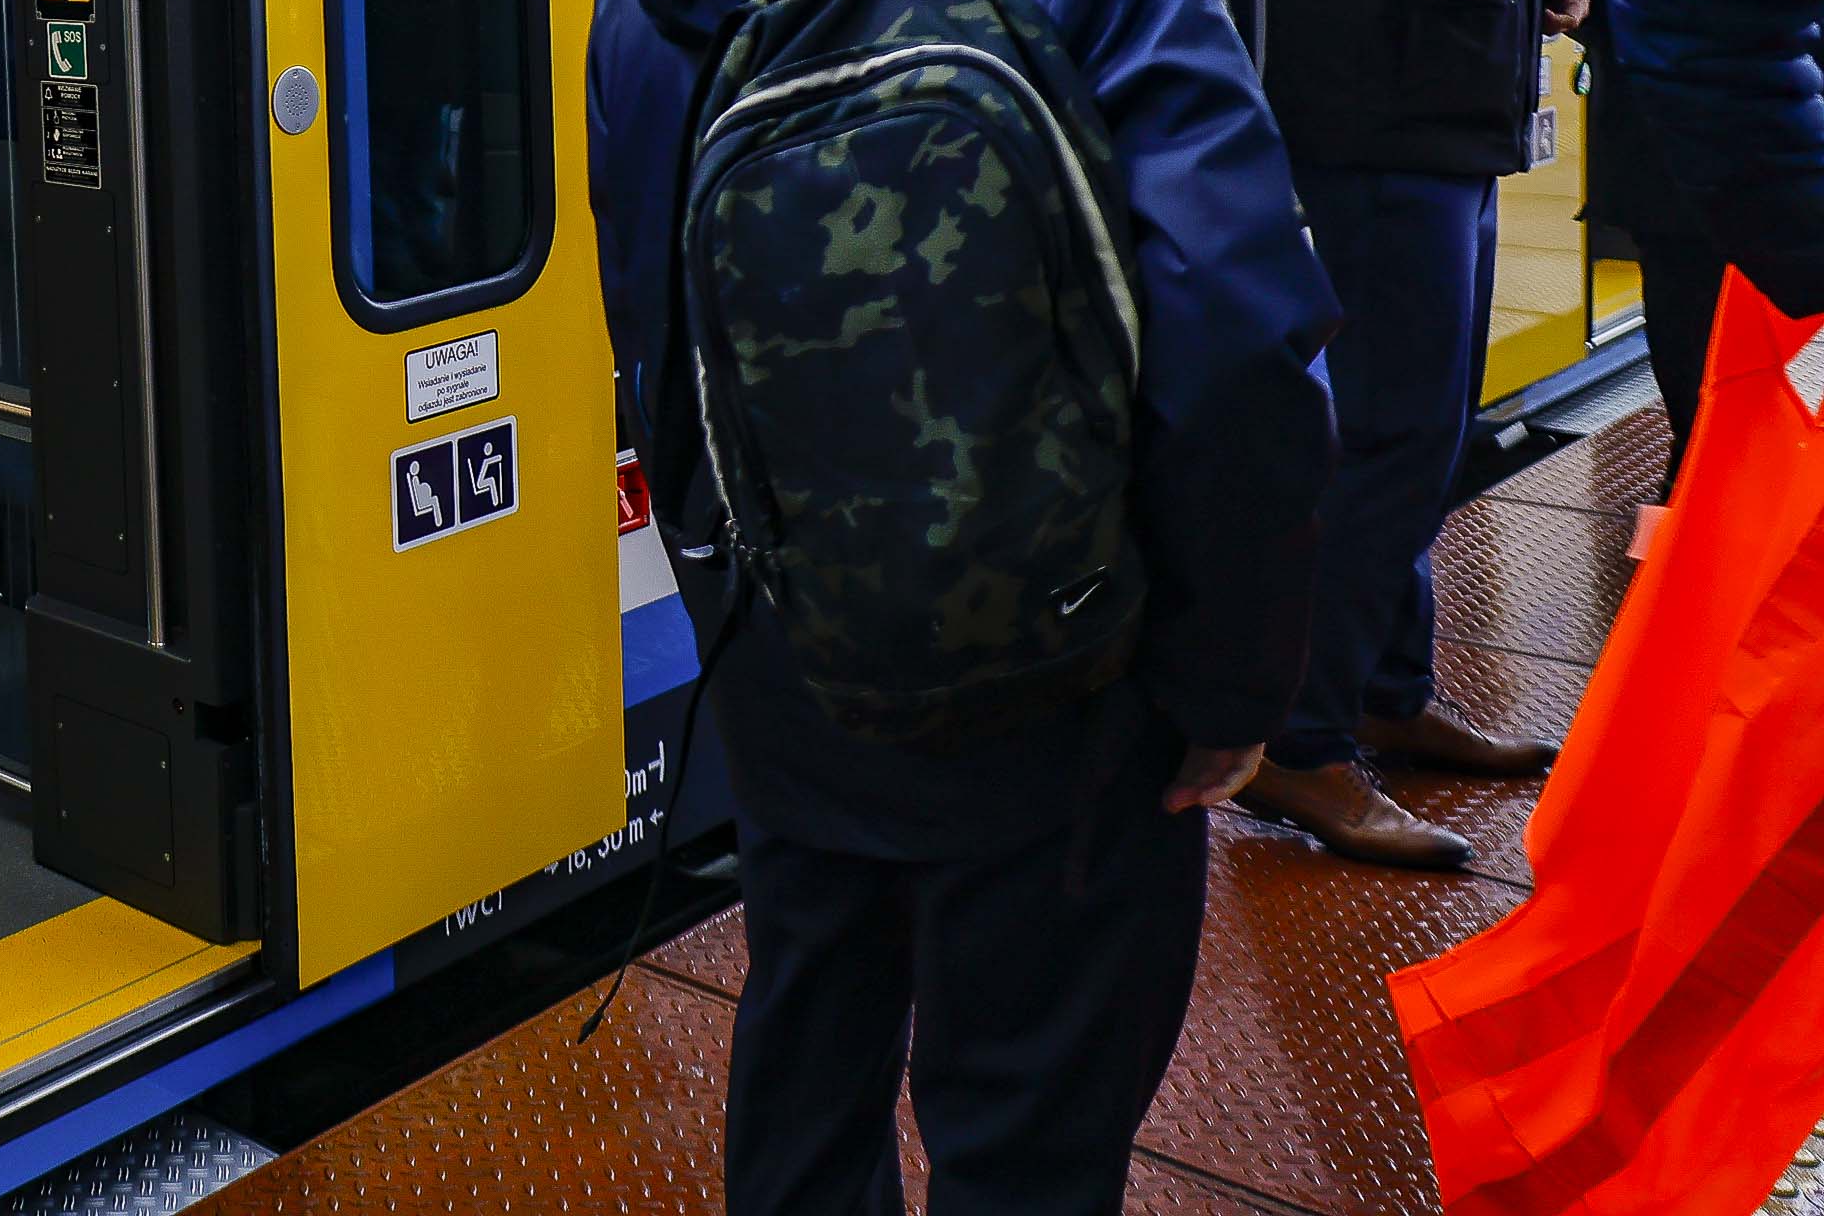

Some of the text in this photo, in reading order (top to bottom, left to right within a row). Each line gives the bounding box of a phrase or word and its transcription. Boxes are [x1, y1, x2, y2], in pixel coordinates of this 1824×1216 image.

[63, 31, 82, 43] SOS
[425, 340, 479, 369] UWAGA!
[417, 374, 450, 389] Wsiadanie
[454, 364, 487, 380] wysiadanie
[436, 380, 470, 397] po sygnale
[418, 386, 488, 412] odjazdu jest zabronione
